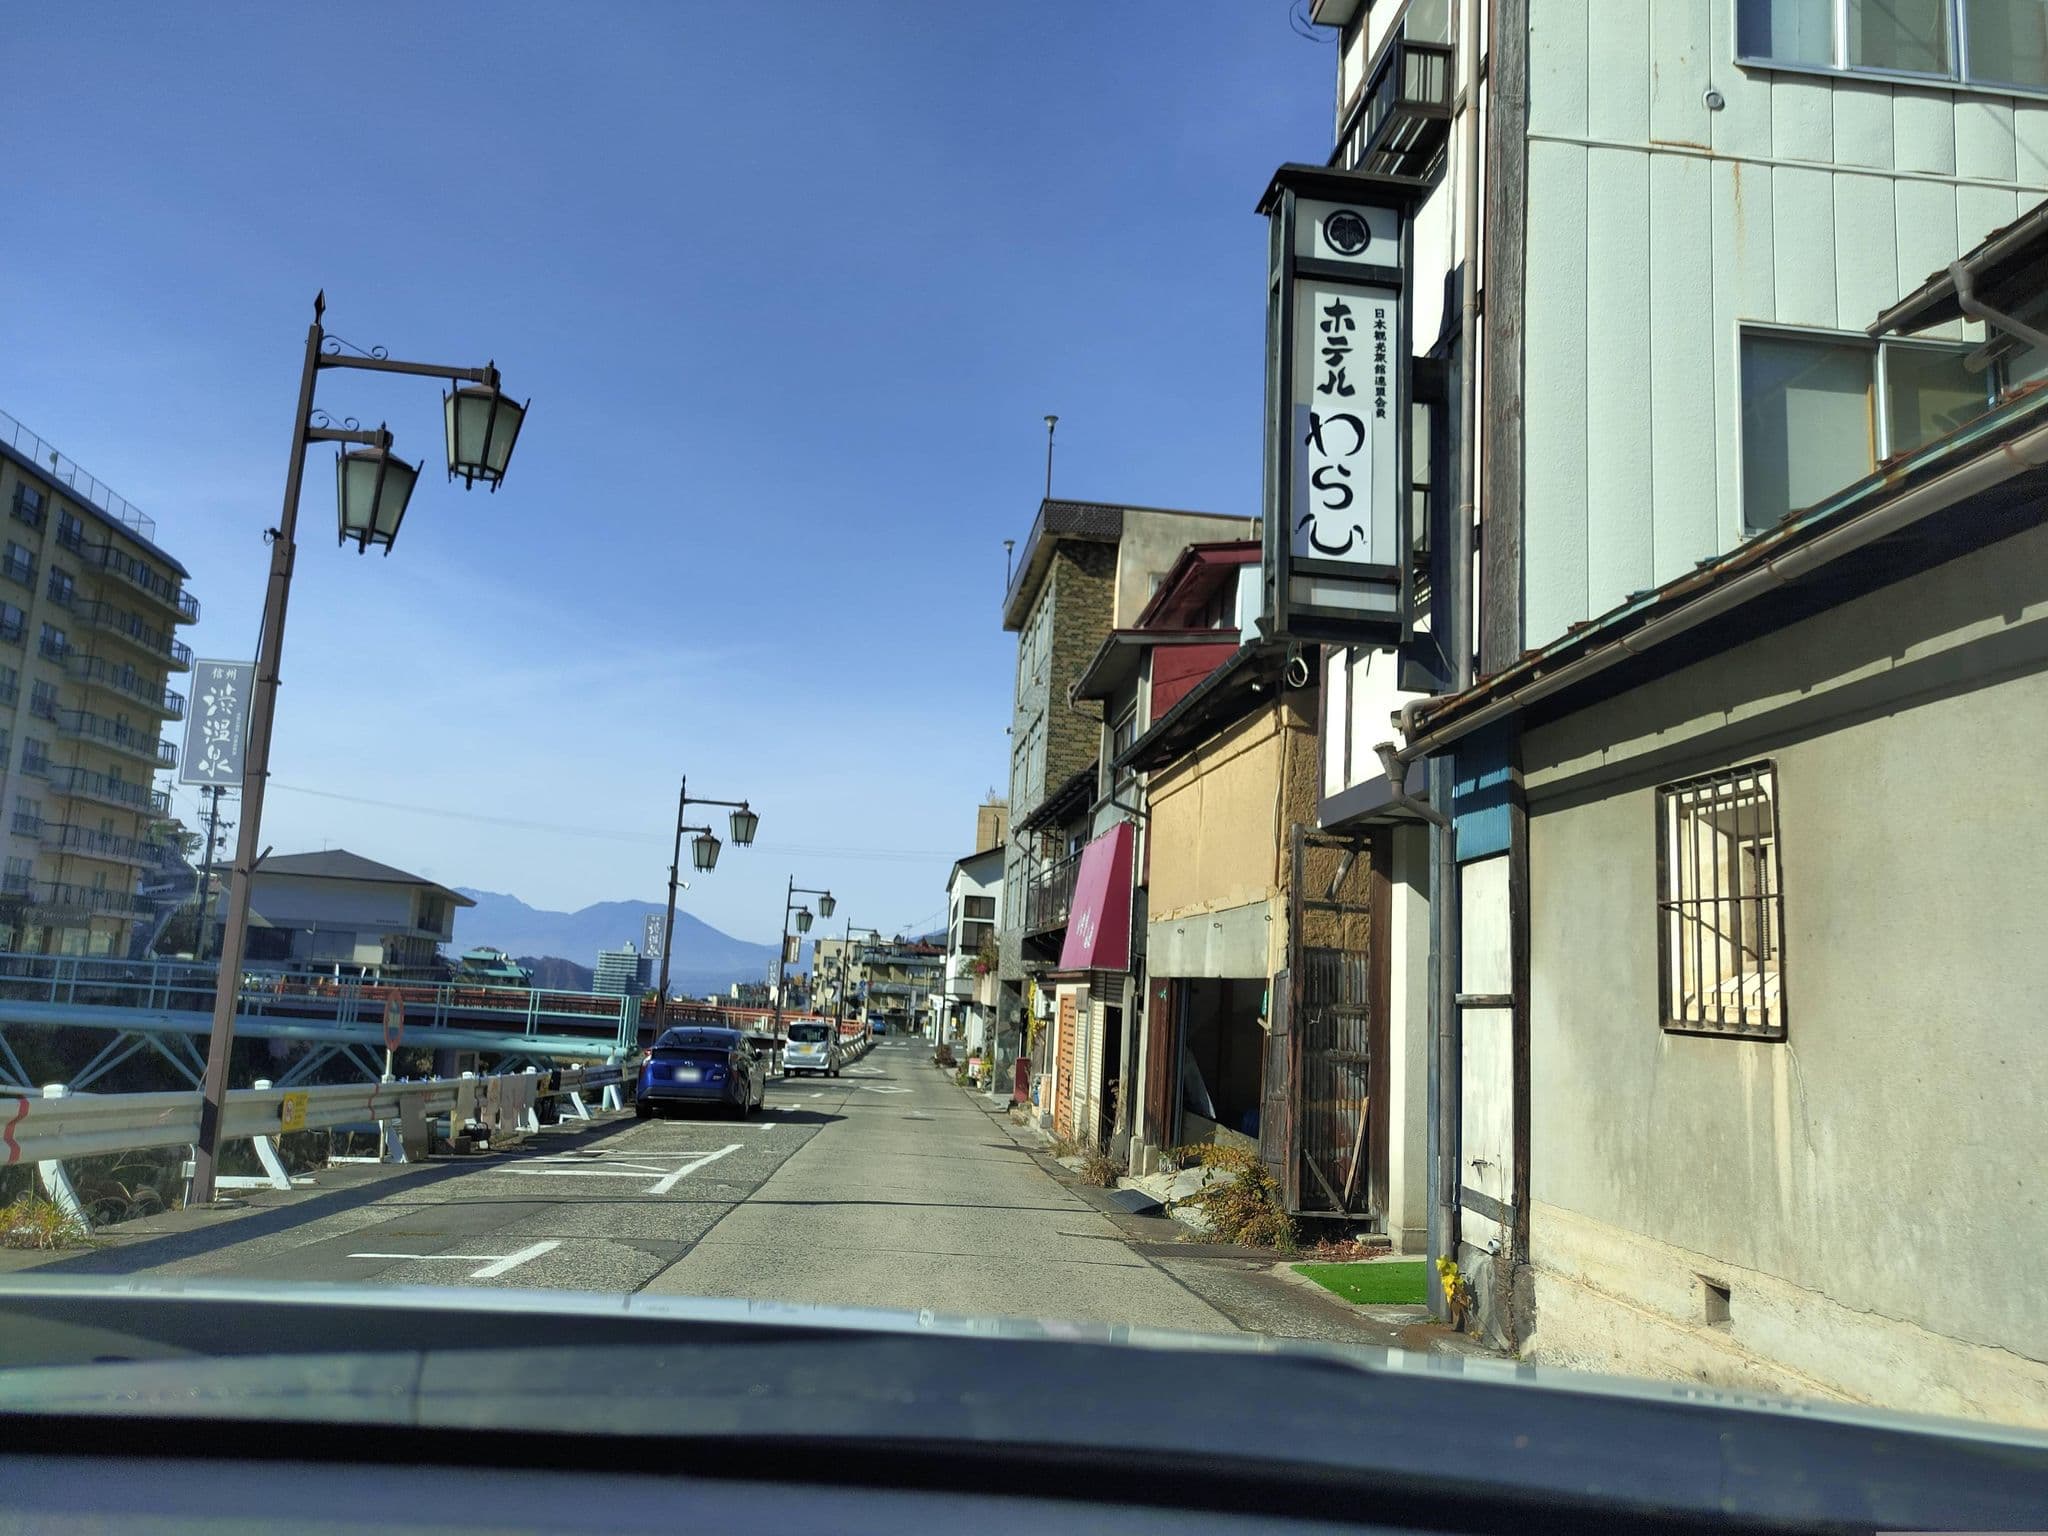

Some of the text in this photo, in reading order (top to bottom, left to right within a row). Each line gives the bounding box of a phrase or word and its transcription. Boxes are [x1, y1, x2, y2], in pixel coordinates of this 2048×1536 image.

[1317, 297, 1356, 397] ホテル
[212, 667, 237, 680] 信州
[199, 683, 237, 778] 渋温泉
